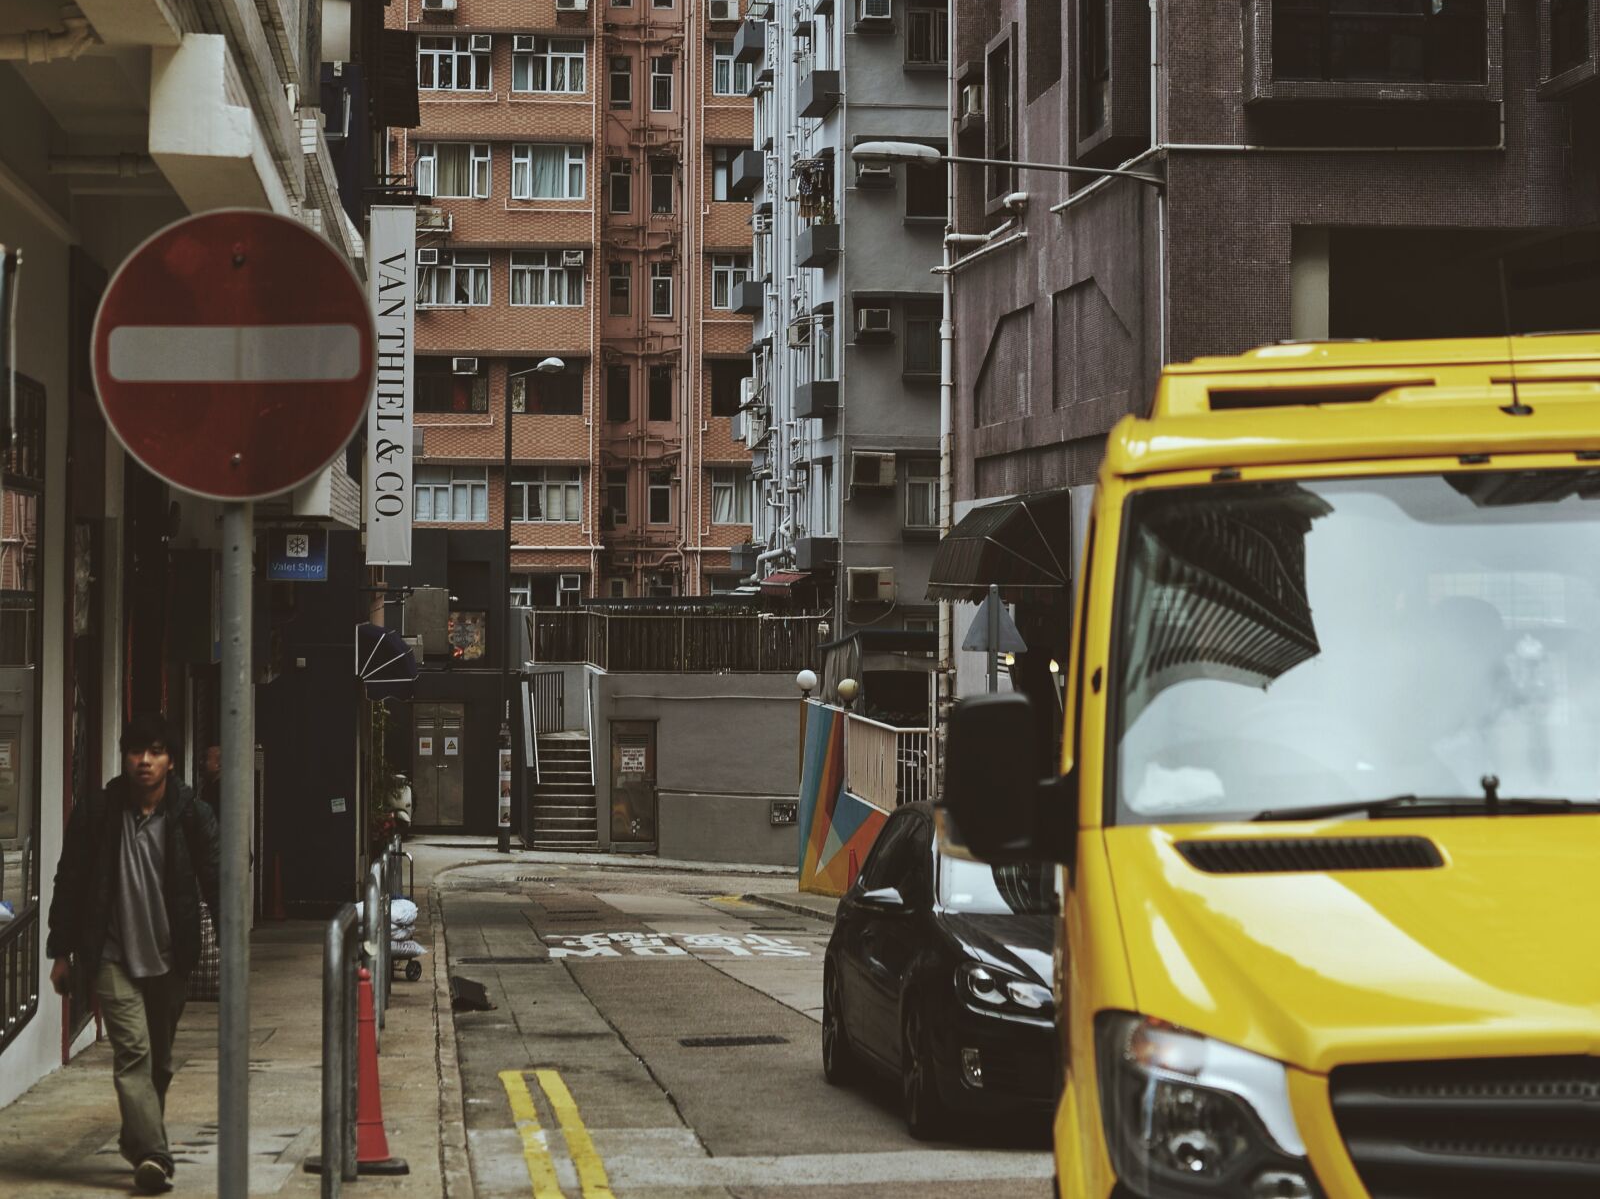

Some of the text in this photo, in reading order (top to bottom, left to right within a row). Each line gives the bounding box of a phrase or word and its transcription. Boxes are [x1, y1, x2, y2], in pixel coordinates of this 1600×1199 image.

[375, 248, 407, 522] VAN THIEL & CO.
[272, 562, 323, 574] Valet Shop
[548, 945, 811, 958] SLOW
